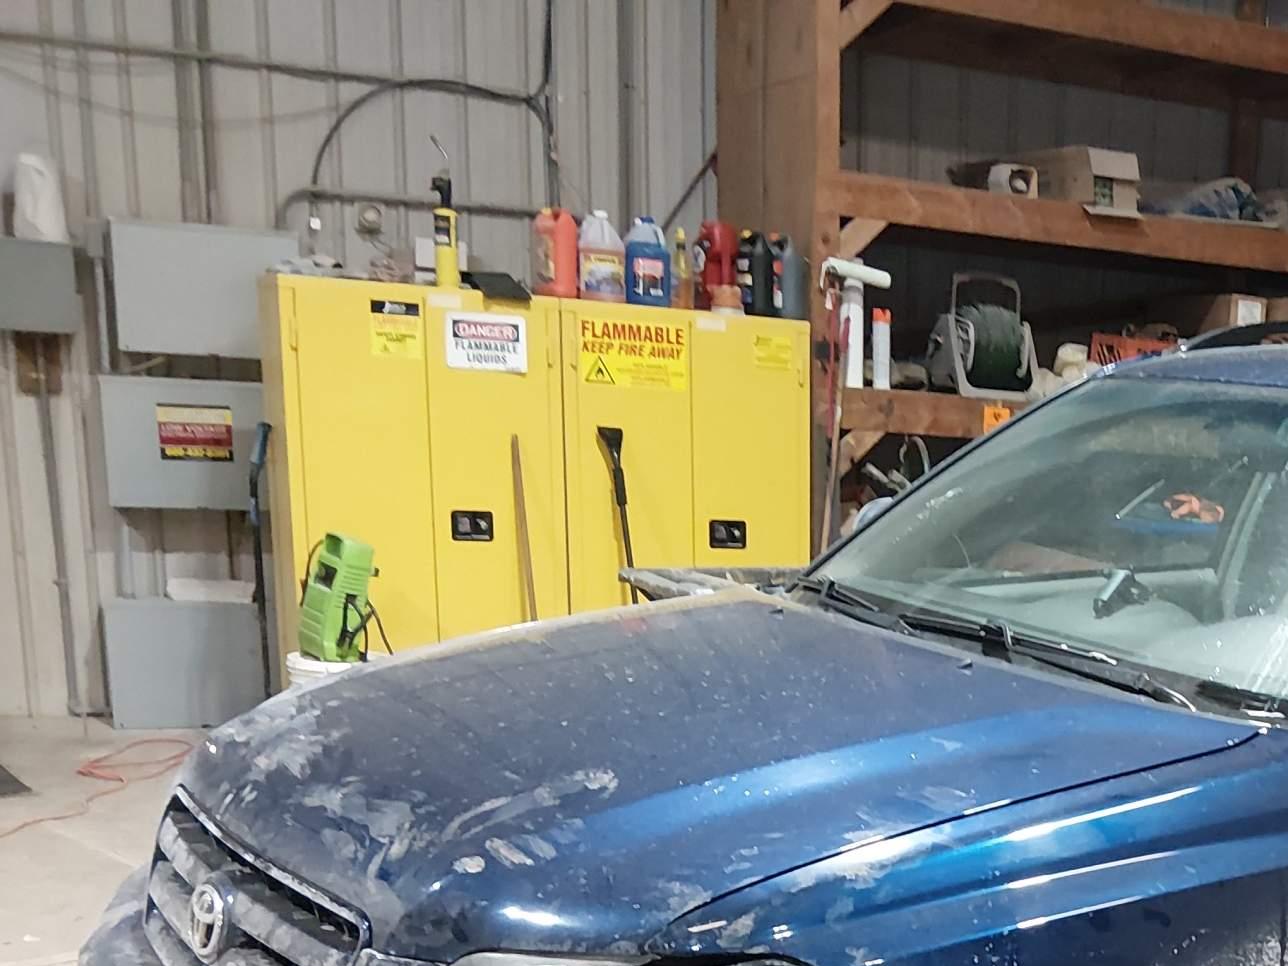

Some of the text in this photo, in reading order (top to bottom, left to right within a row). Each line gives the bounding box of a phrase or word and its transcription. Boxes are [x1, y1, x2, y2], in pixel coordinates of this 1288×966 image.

[457, 322, 514, 340] DANGER
[581, 320, 685, 346] FLAMMABLE
[454, 340, 518, 354] FLAMMABLE
[581, 340, 684, 361] KEEP FIRE AWAY
[466, 352, 508, 365] LIQUIDS
